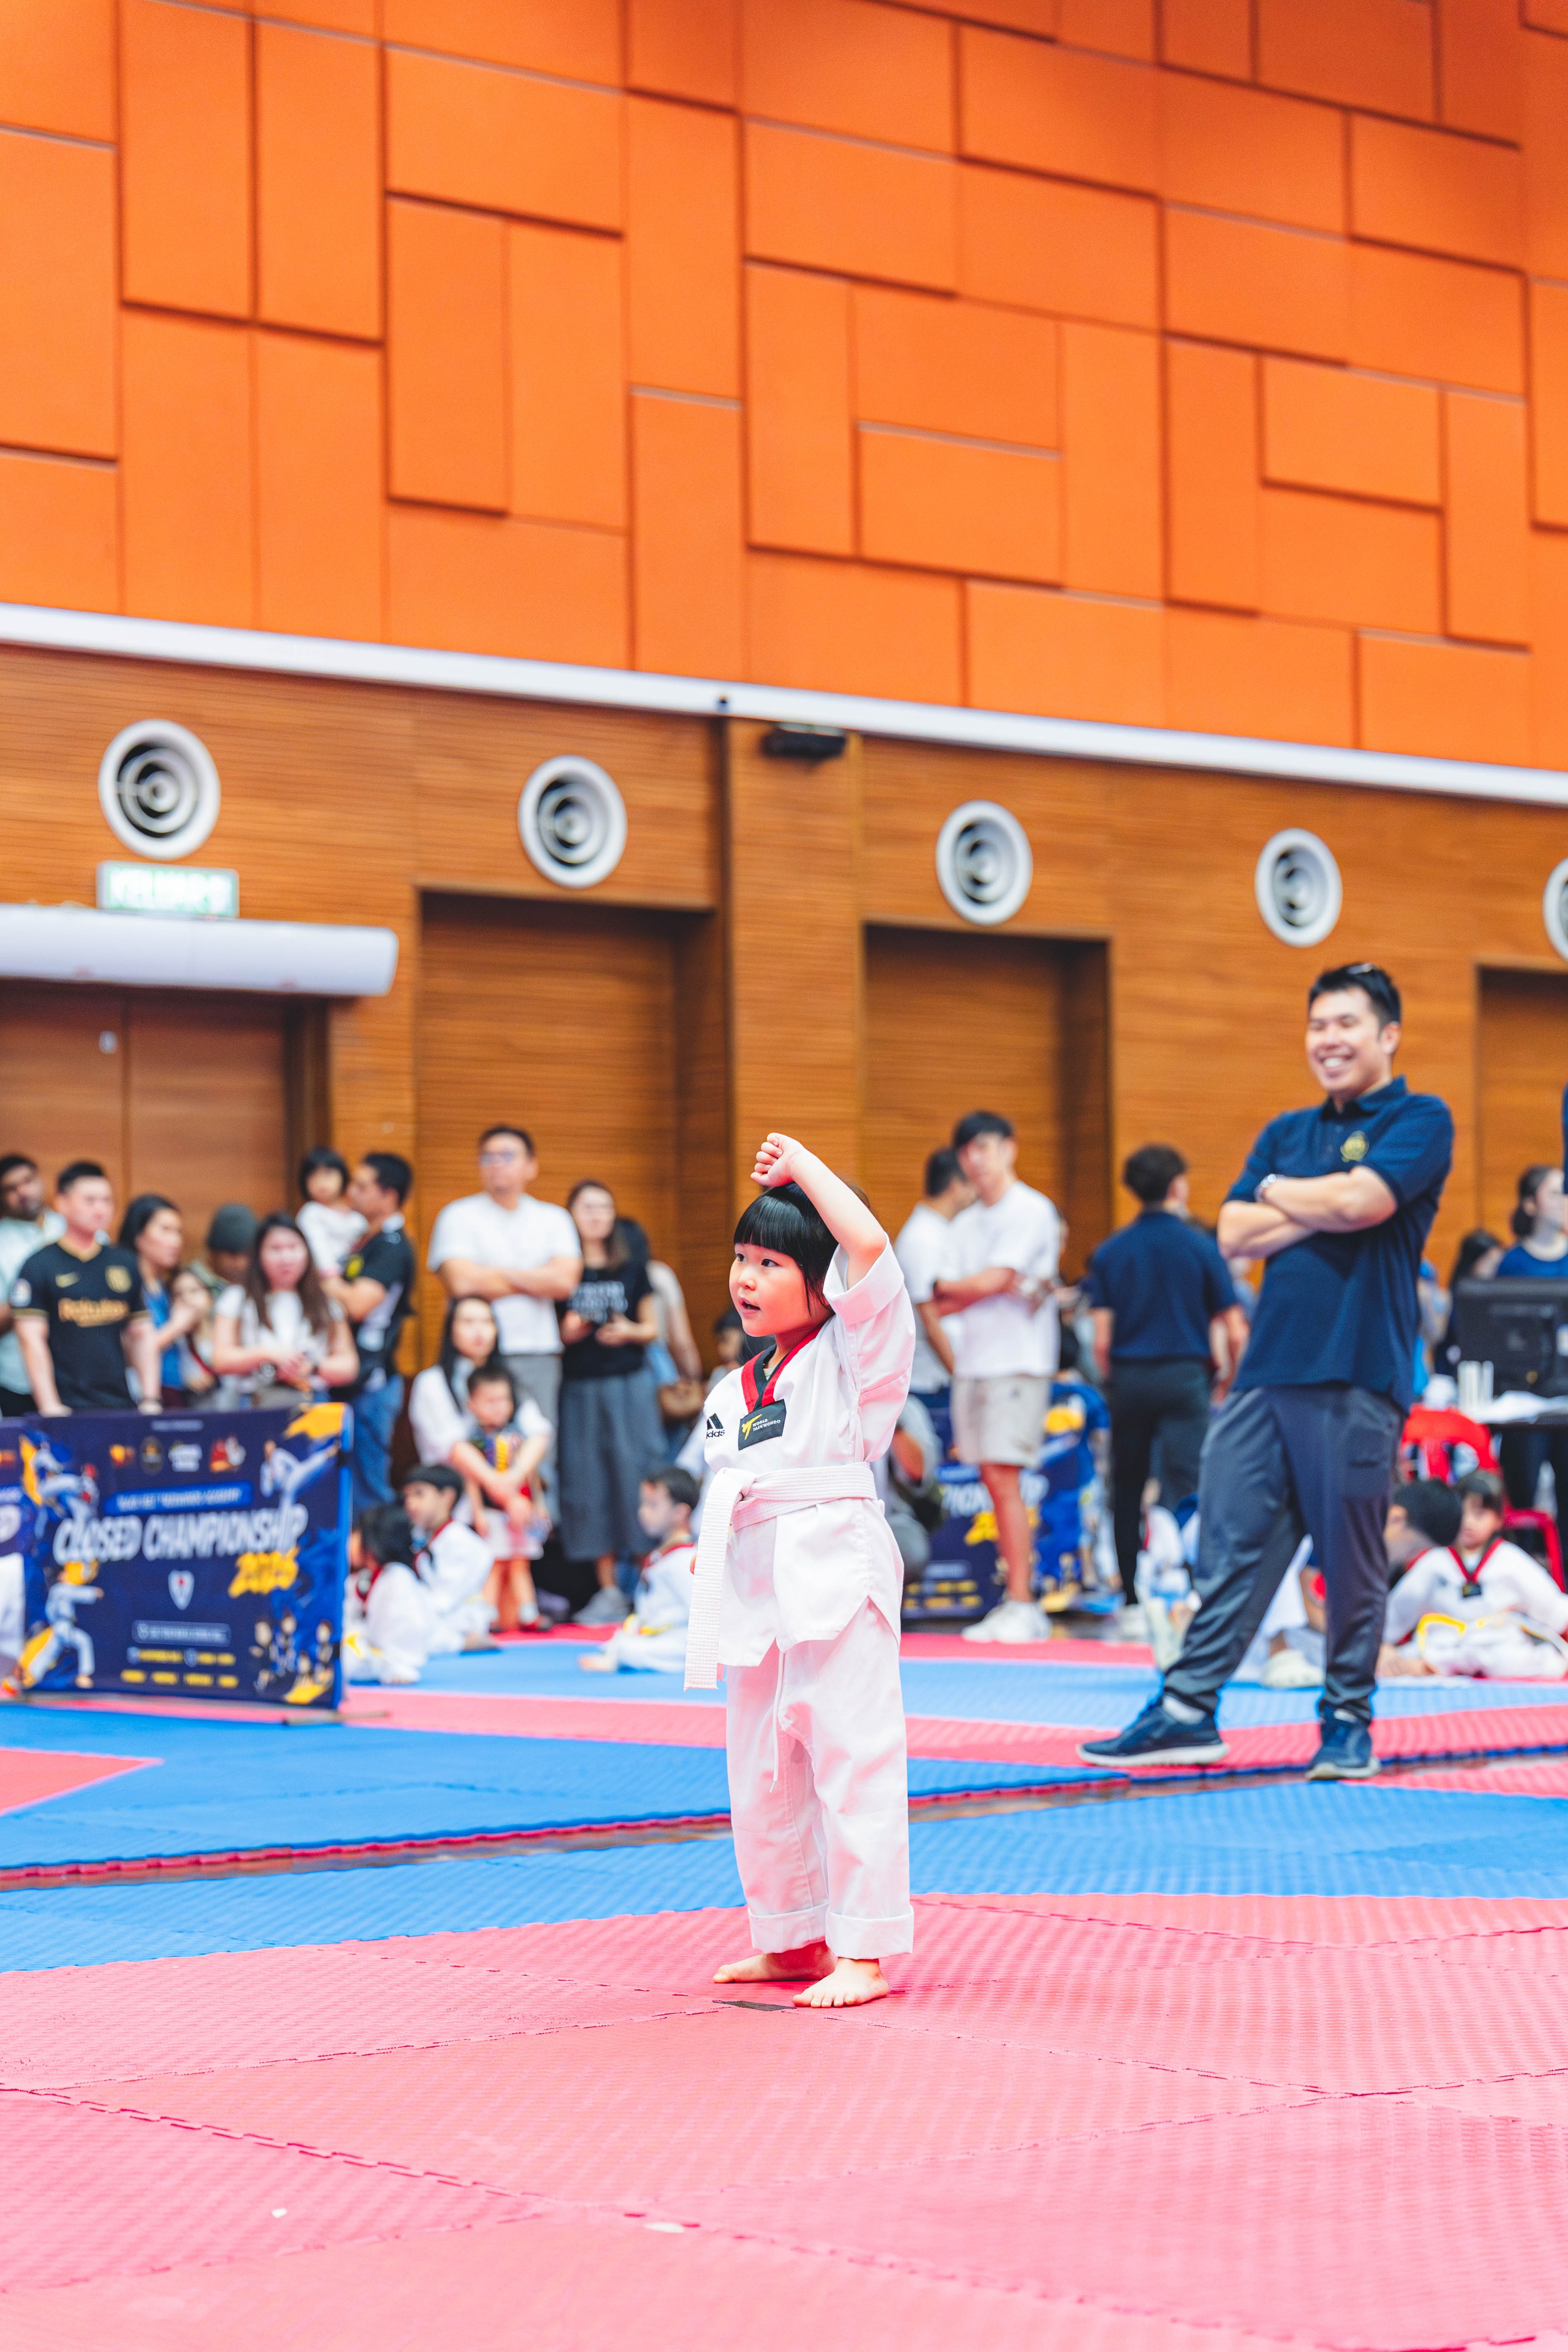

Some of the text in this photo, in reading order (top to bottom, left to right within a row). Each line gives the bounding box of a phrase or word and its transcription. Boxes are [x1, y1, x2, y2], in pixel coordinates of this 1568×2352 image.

[752, 1418, 768, 1427] WORLD
[753, 1419, 781, 1431] TAEKWONDO
[54, 1515, 143, 1565] CLOSED
